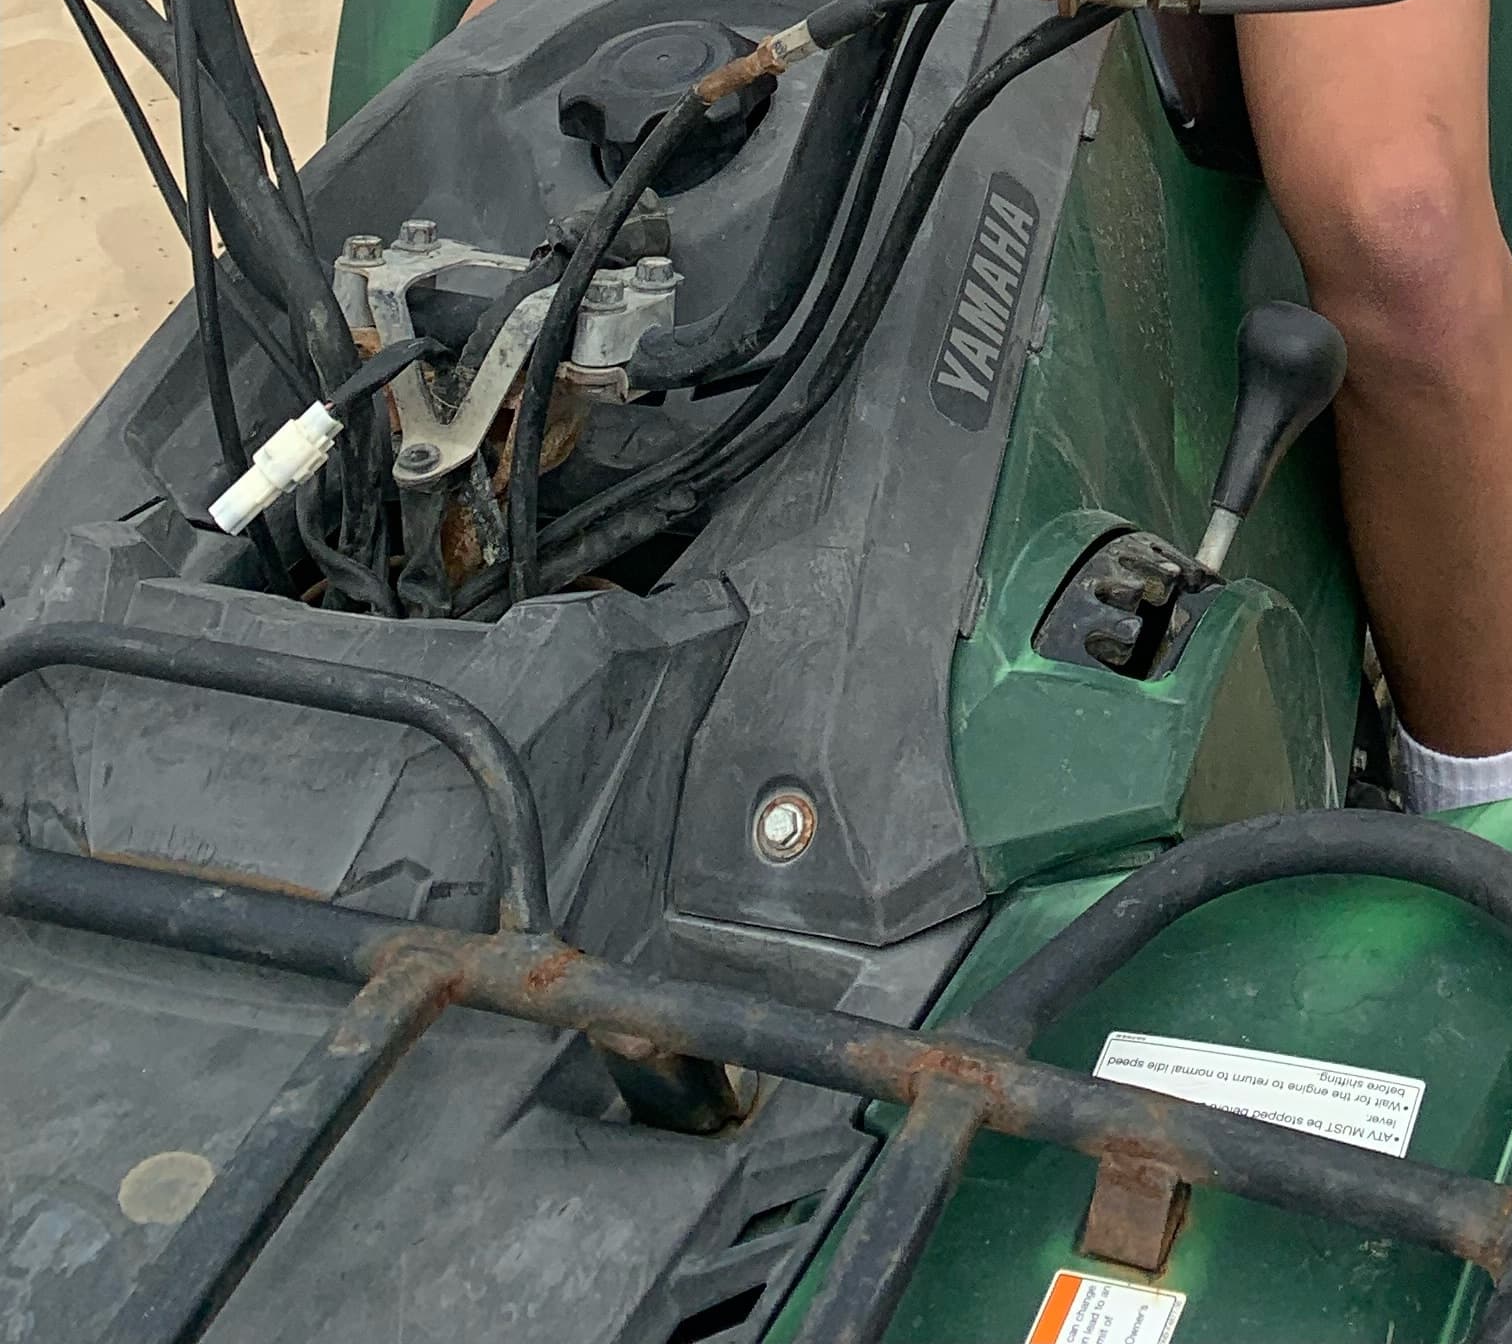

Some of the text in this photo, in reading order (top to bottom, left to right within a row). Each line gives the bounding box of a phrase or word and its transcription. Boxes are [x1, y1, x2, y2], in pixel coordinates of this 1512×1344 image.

[936, 191, 1034, 403] YAMAHA
[1106, 1056, 1401, 1112] Wait for the engine to return to normal idle speed
[1366, 1081, 1406, 1099] before
[1253, 1109, 1304, 1126] stopped
[1306, 1117, 1323, 1131] be
[1325, 1121, 1365, 1139] MUST
[1367, 1131, 1393, 1143] ATV
[1075, 1284, 1097, 1323] change
[1093, 1300, 1106, 1311] to
